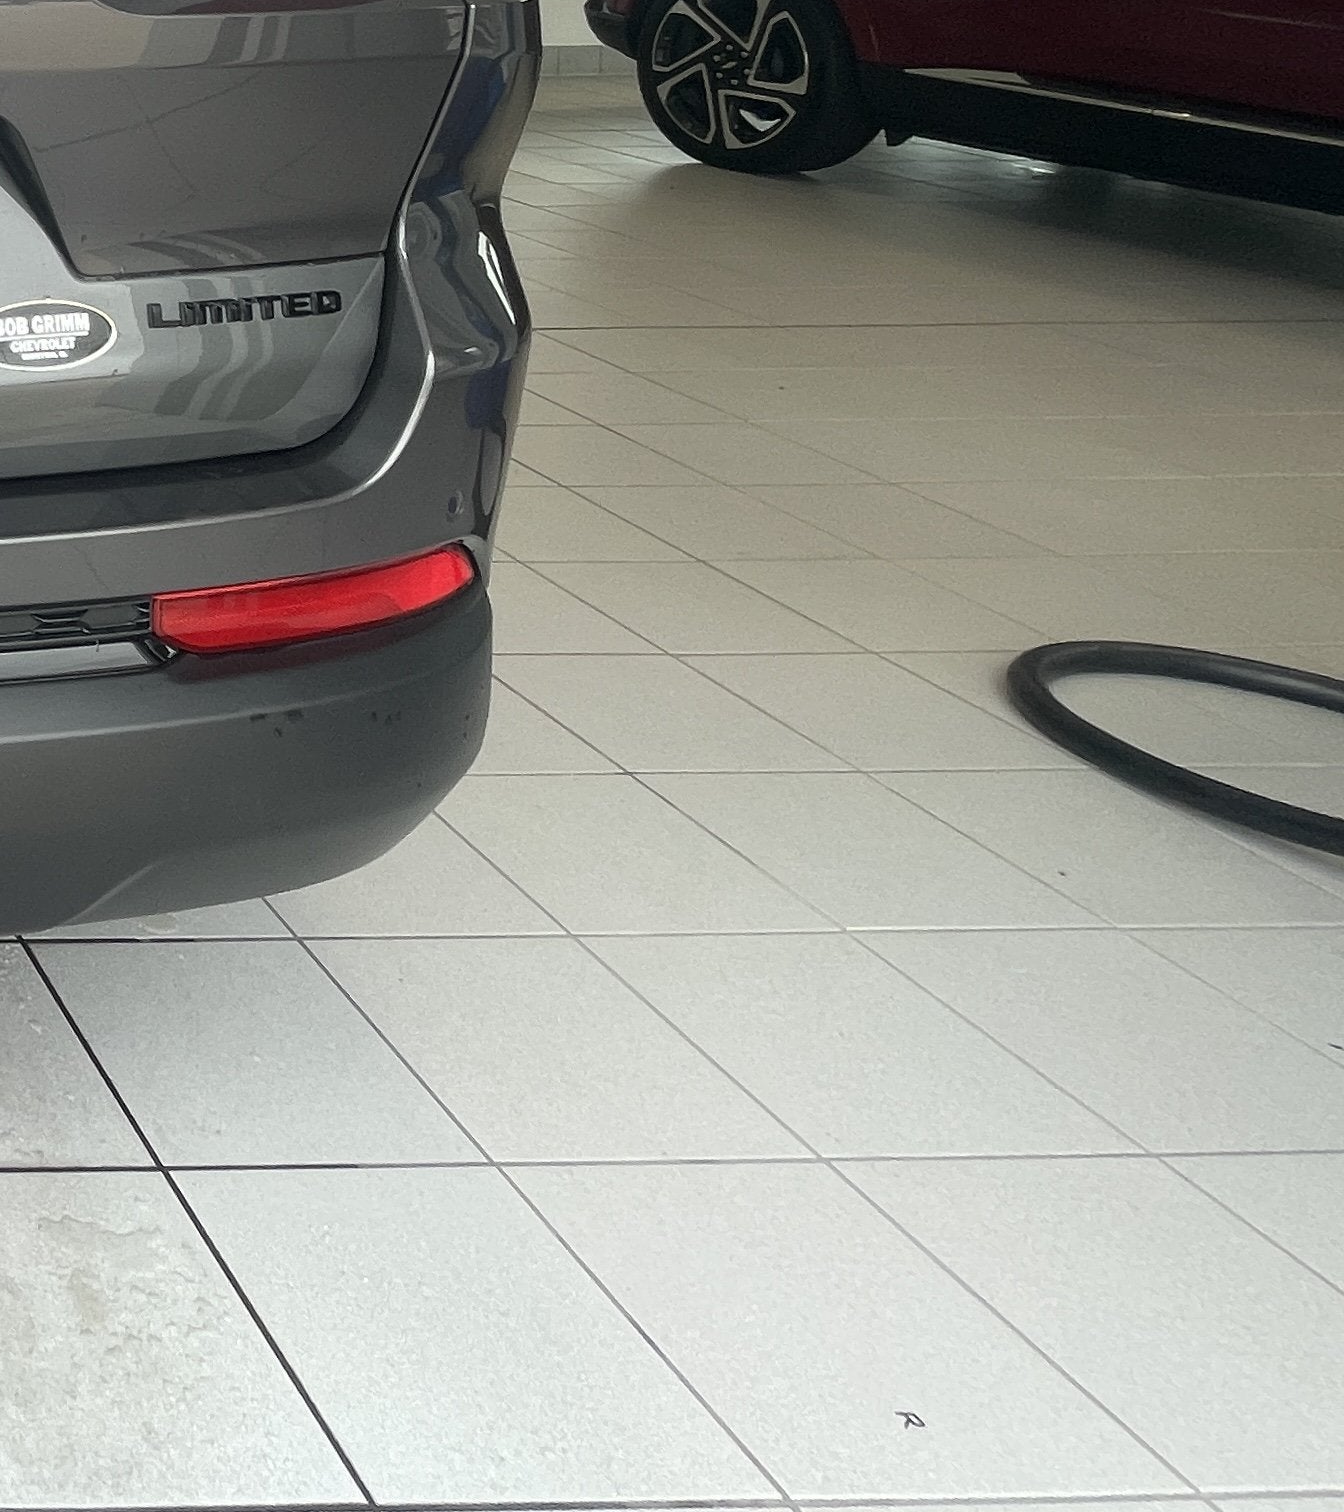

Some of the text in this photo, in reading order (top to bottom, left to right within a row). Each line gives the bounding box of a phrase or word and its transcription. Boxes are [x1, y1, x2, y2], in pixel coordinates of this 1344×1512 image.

[146, 290, 342, 329] LIMITED
[31, 312, 90, 334] GRIMM
[9, 337, 77, 353] CHEVROLET
